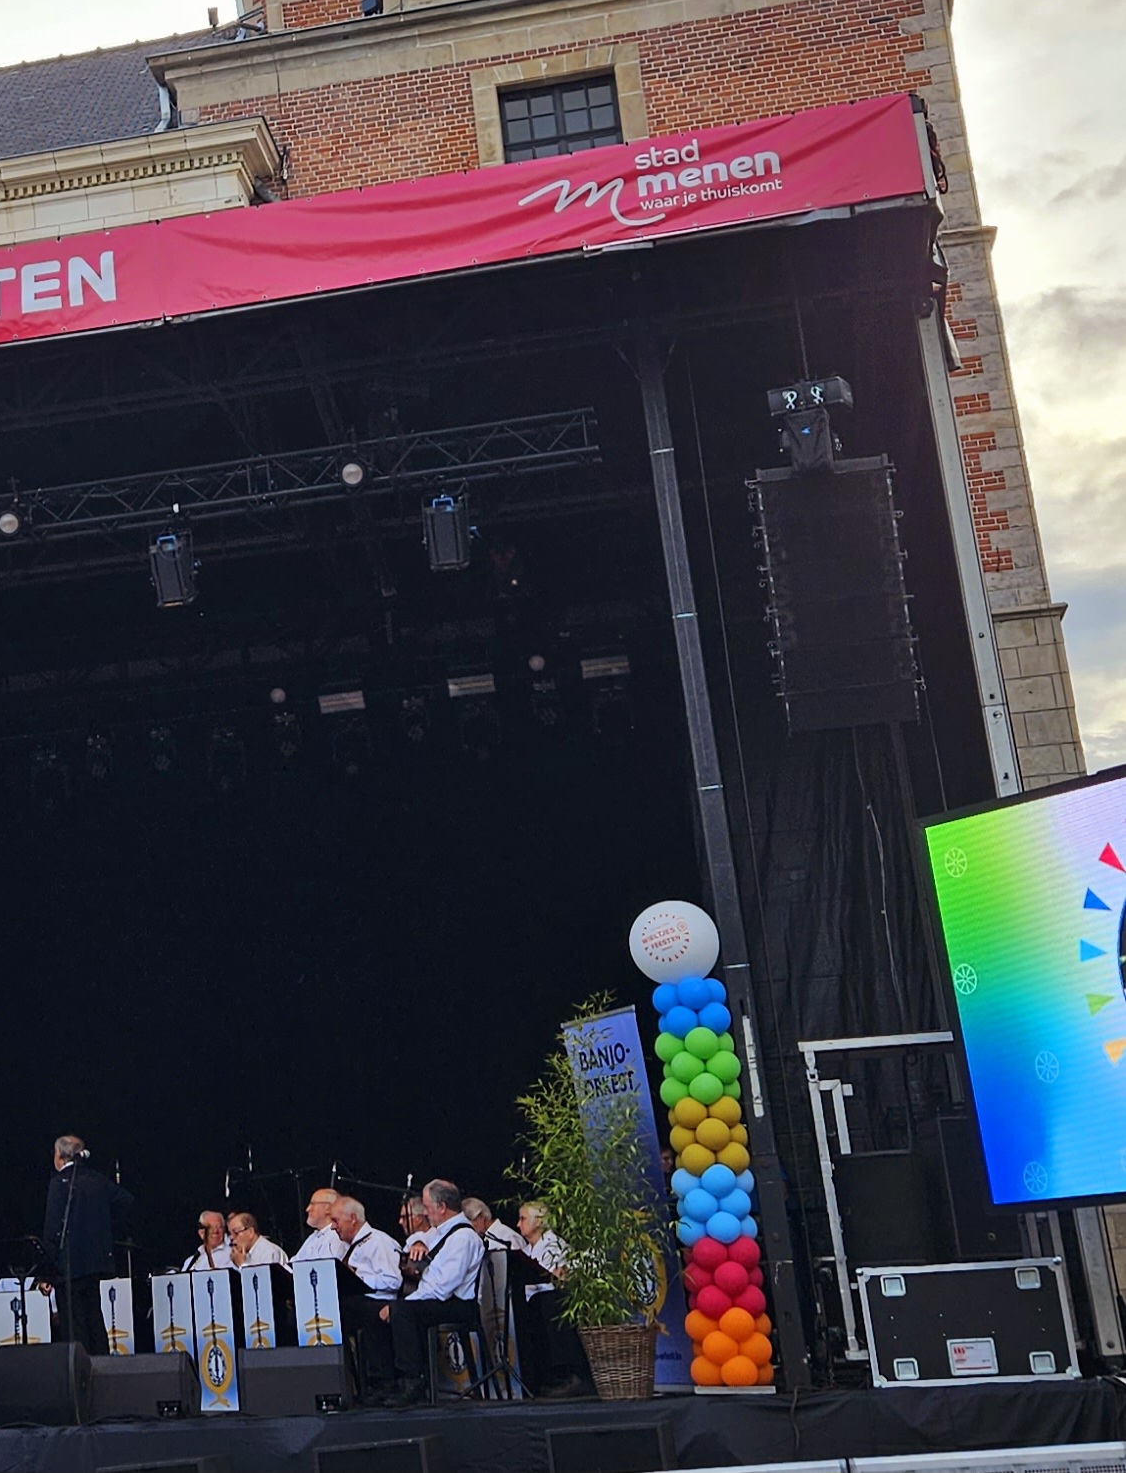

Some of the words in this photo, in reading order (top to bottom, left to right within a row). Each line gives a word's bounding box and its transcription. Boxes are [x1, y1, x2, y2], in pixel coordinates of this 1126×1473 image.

[634, 138, 700, 170] stad
[637, 151, 781, 197] menen
[640, 195, 680, 211] waar
[681, 191, 697, 207] je
[700, 178, 783, 201] thuiskomt
